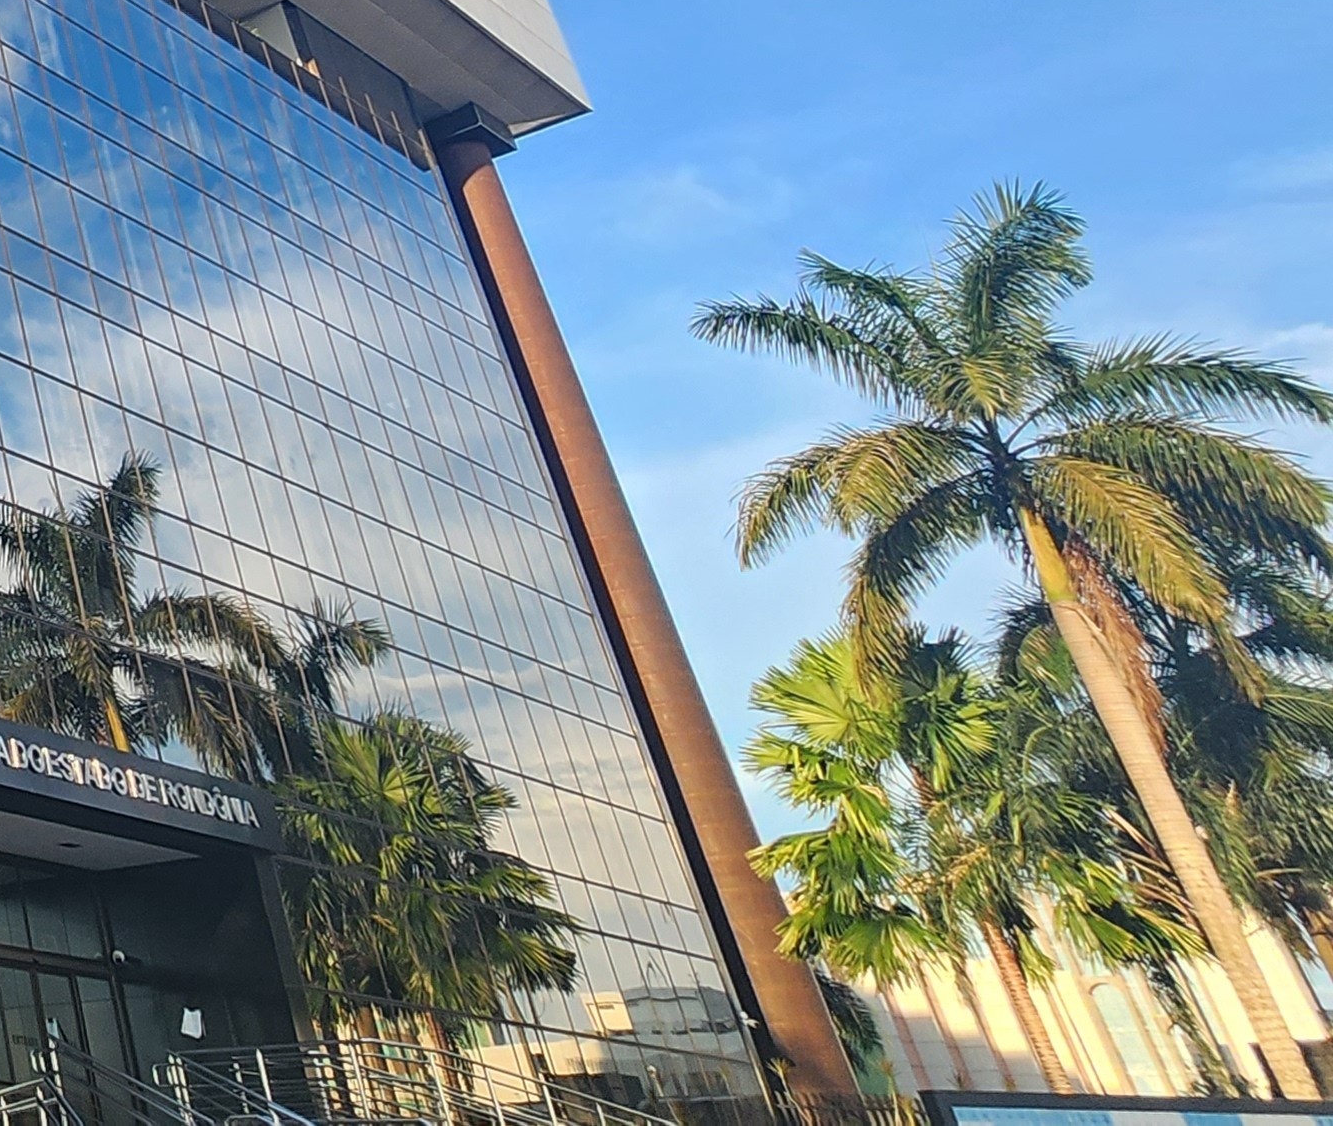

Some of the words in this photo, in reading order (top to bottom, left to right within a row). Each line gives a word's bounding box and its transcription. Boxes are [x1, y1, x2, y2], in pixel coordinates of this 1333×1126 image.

[42, 746, 128, 796] ESTADO
[124, 767, 160, 802] DE
[159, 776, 261, 829] RONDÔNIA
